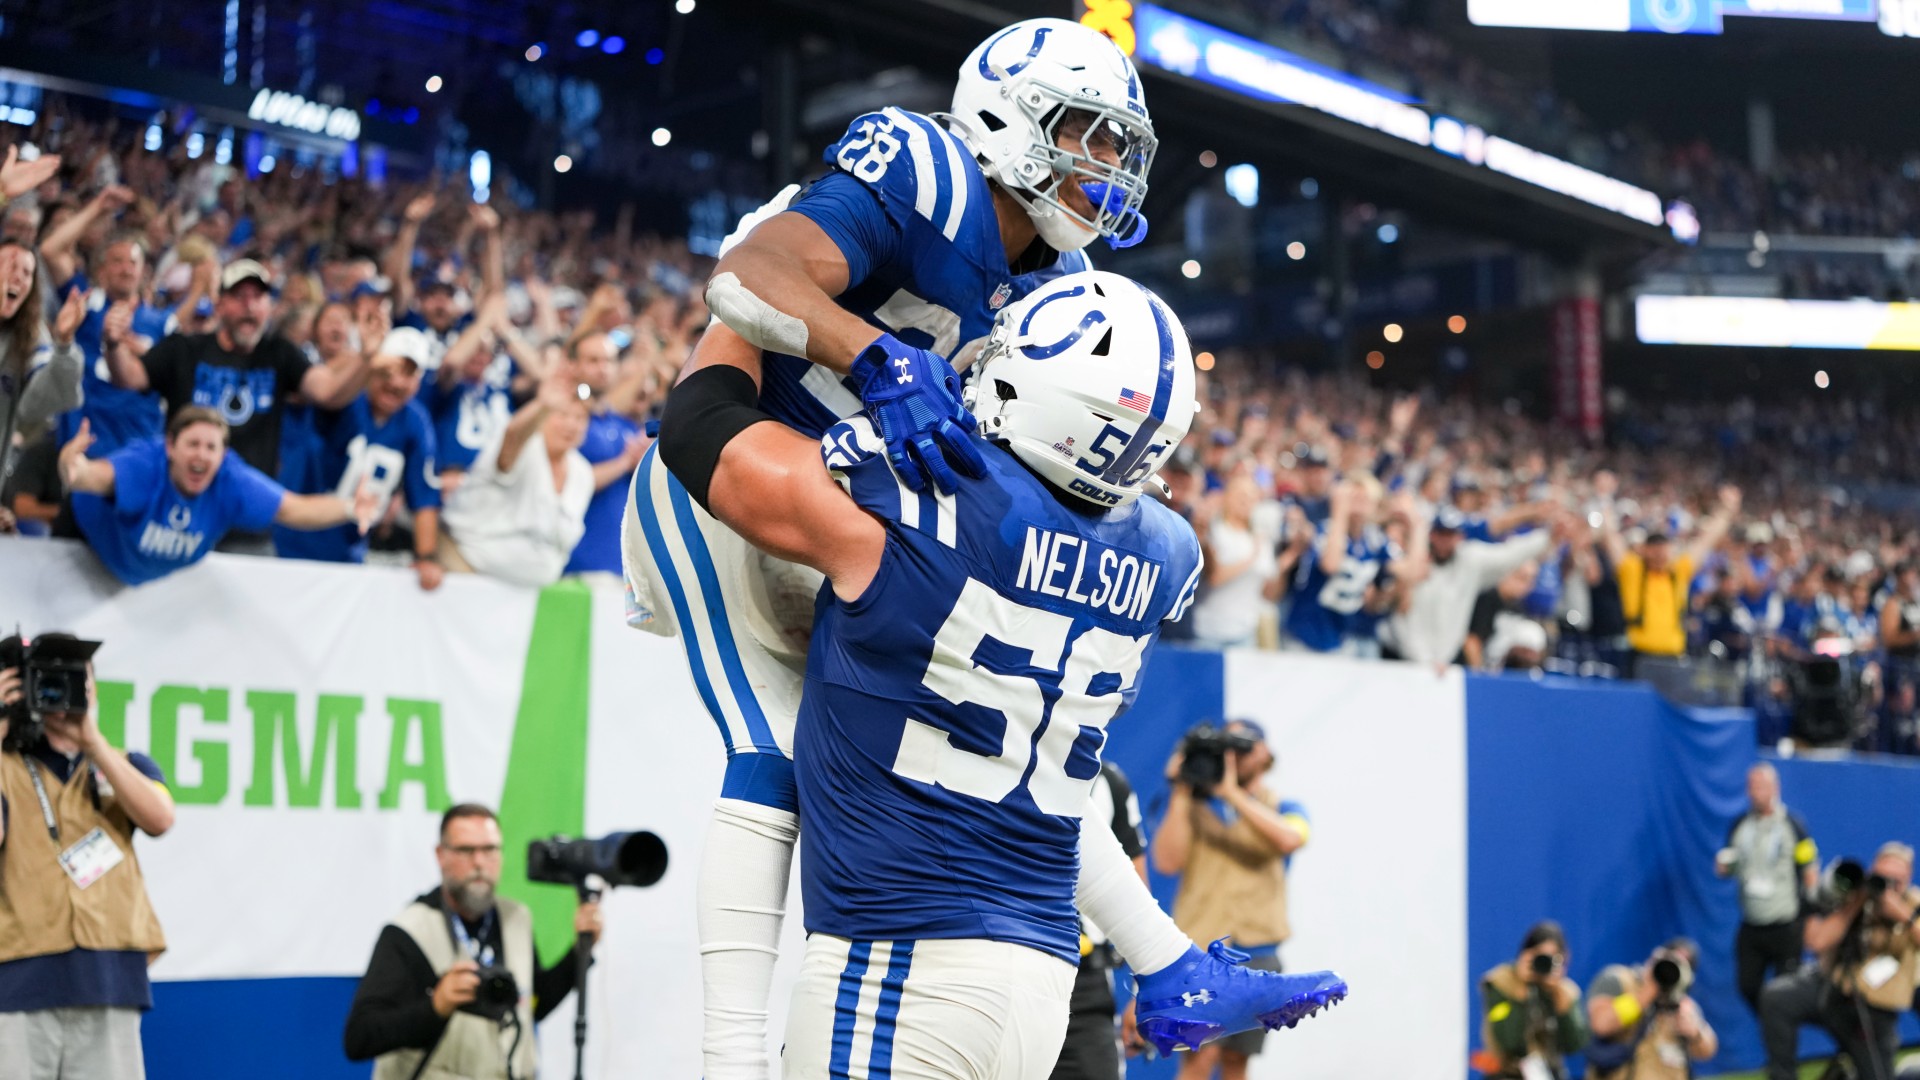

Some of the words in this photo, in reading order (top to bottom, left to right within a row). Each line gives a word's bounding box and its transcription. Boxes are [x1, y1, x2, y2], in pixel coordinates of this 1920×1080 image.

[837, 120, 902, 182] 28
[1068, 478, 1123, 505] COLTS
[1075, 423, 1167, 487] 56
[1015, 526, 1161, 622] NELSON
[892, 576, 1153, 818] 56
[93, 679, 452, 812] IGMA
